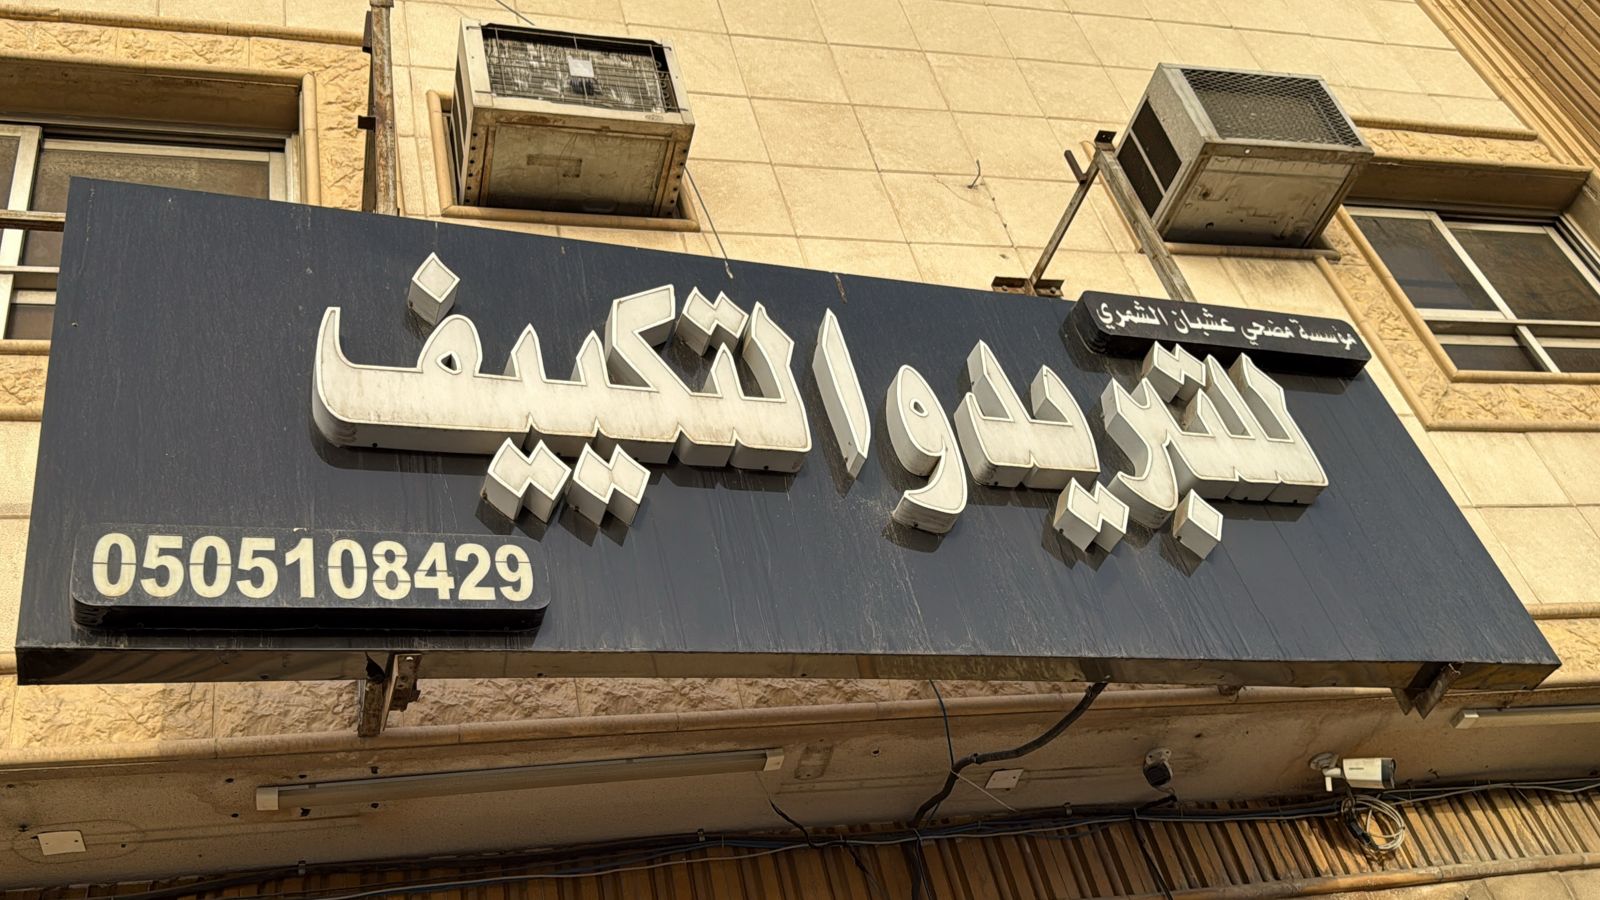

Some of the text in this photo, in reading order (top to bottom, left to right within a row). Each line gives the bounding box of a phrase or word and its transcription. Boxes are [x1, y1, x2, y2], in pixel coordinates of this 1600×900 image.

[1096, 300, 1168, 330] الشمري
[1241, 319, 1295, 346] مضحي
[1288, 318, 1357, 350] مؤسسة
[955, 339, 1330, 555] للتبريد
[92, 532, 534, 602] 0505108429
